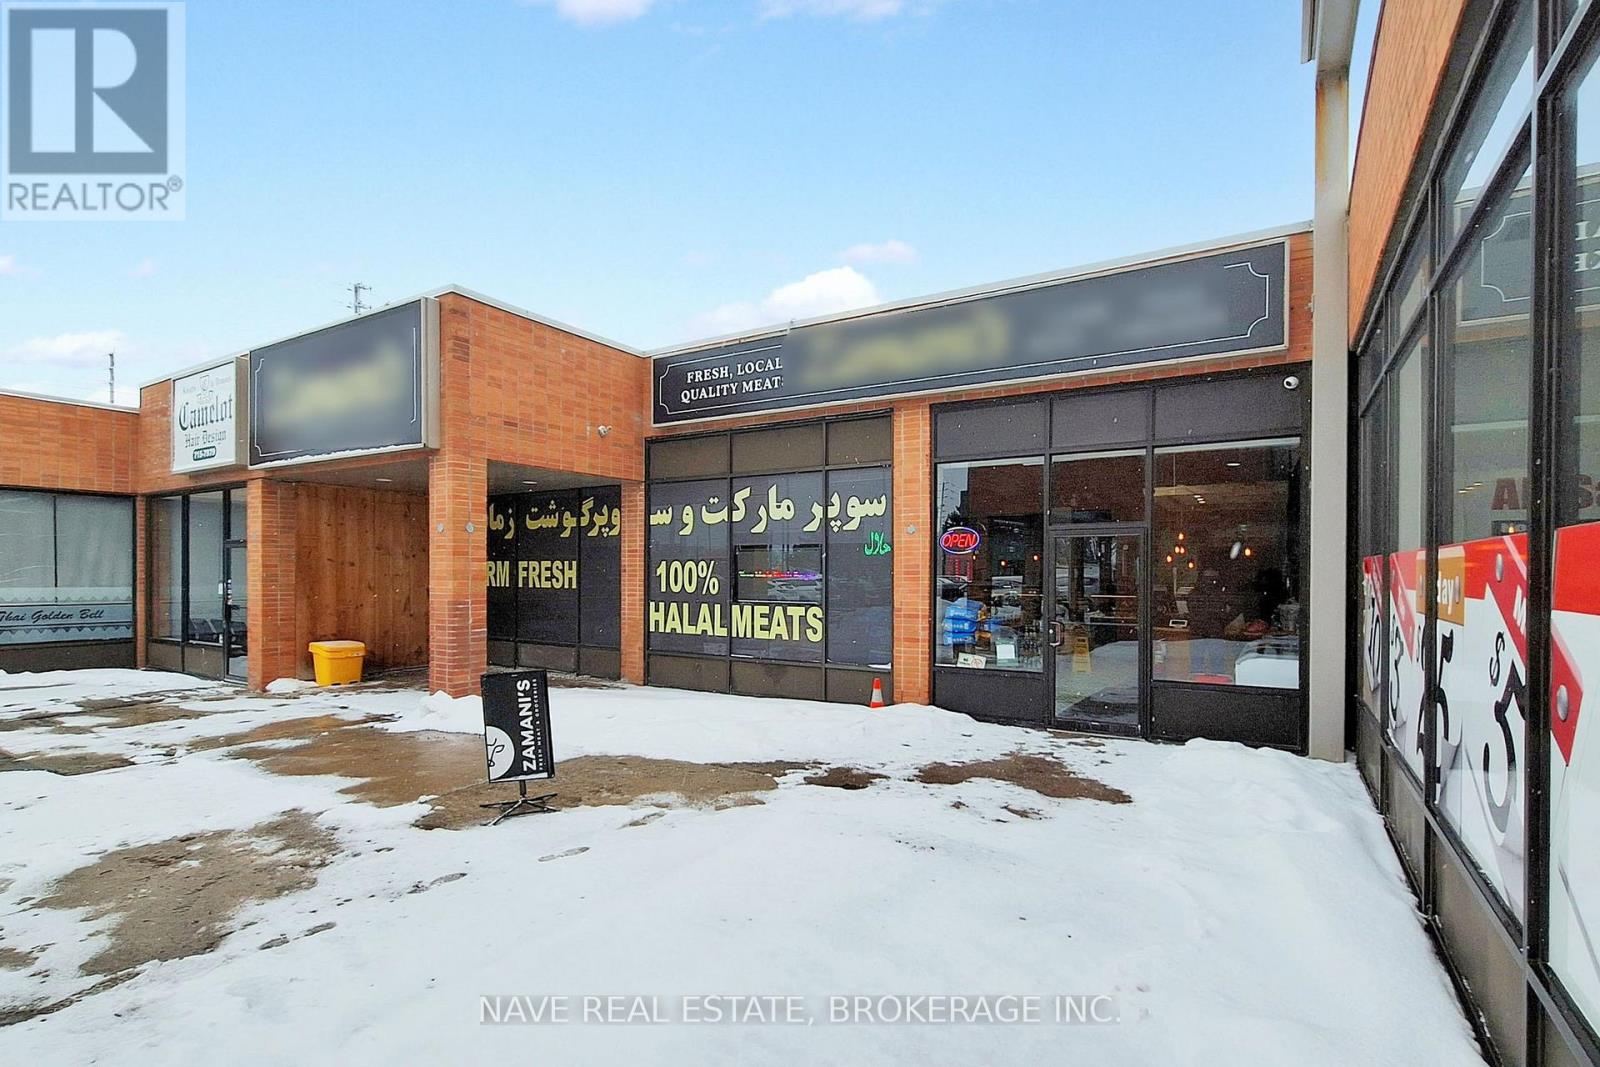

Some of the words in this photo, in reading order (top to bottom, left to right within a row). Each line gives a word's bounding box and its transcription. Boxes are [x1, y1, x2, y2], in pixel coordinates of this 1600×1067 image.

[686, 366, 734, 384] FRESH,
[737, 357, 783, 376] LOCAL
[681, 383, 739, 403] QUALITY
[179, 393, 233, 431] Camelot
[185, 433, 200, 448] Hair
[202, 430, 227, 446] Design
[679, 505, 694, 536] و
[802, 491, 887, 533] سوپر
[943, 533, 976, 549] OPEN
[518, 560, 577, 589] FRESH
[656, 560, 719, 595] 100%
[0, 611, 27, 622] Thai
[31, 609, 73, 624] Golden
[80, 608, 105, 620] Bell
[650, 602, 728, 637] HALAL
[731, 604, 823, 642] MEATS
[516, 679, 537, 772] ZAMANI'S
